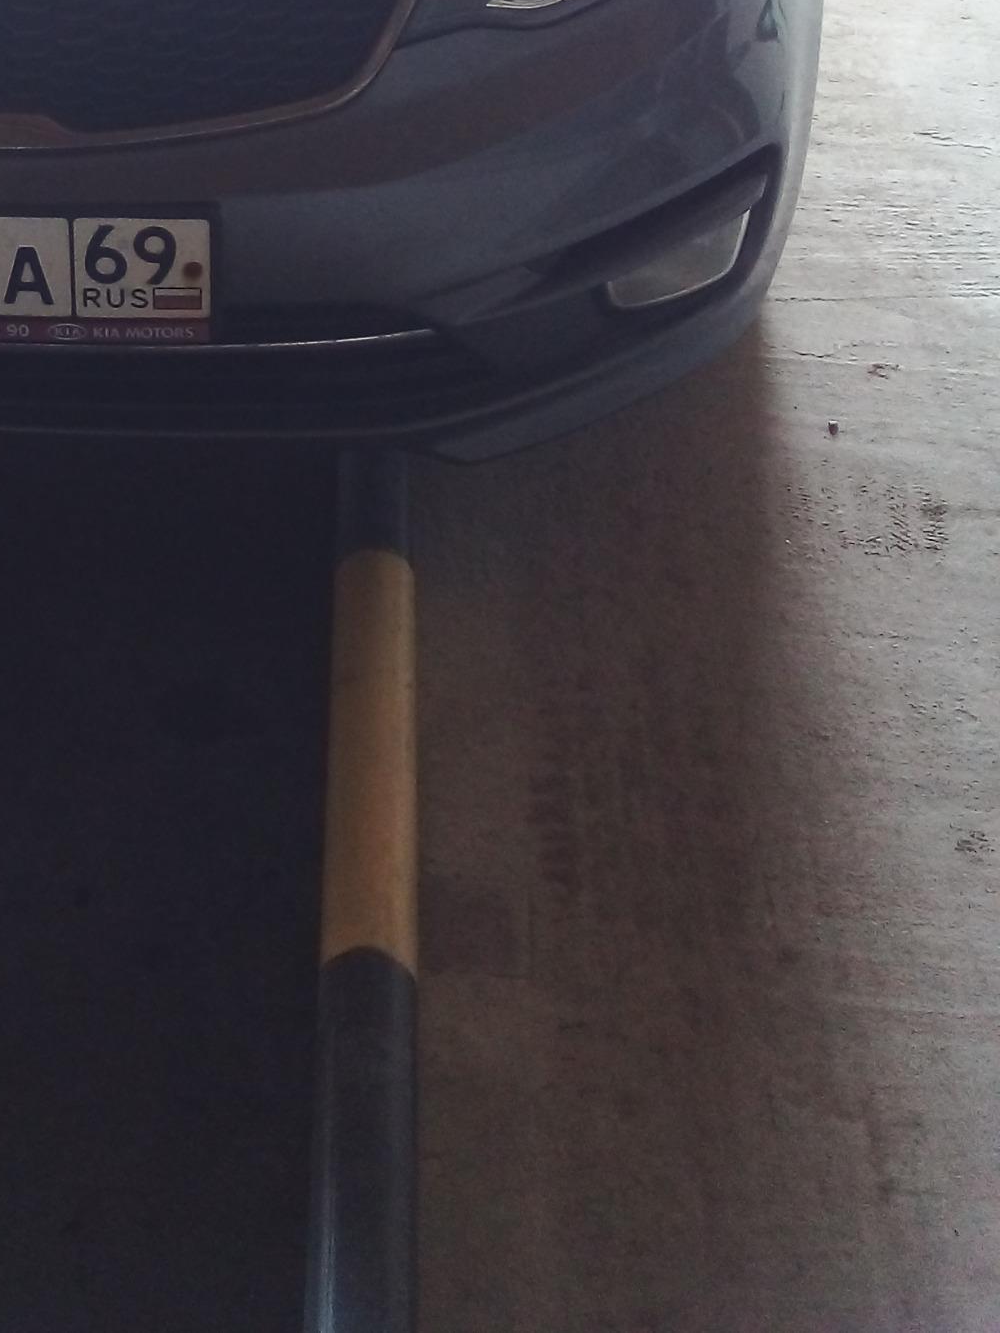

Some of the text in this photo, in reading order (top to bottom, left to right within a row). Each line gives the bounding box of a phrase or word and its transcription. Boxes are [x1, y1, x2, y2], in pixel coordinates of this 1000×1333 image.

[84, 224, 178, 285] 69
[83, 287, 150, 308] RUS
[93, 327, 195, 340] KIA MOTORS
